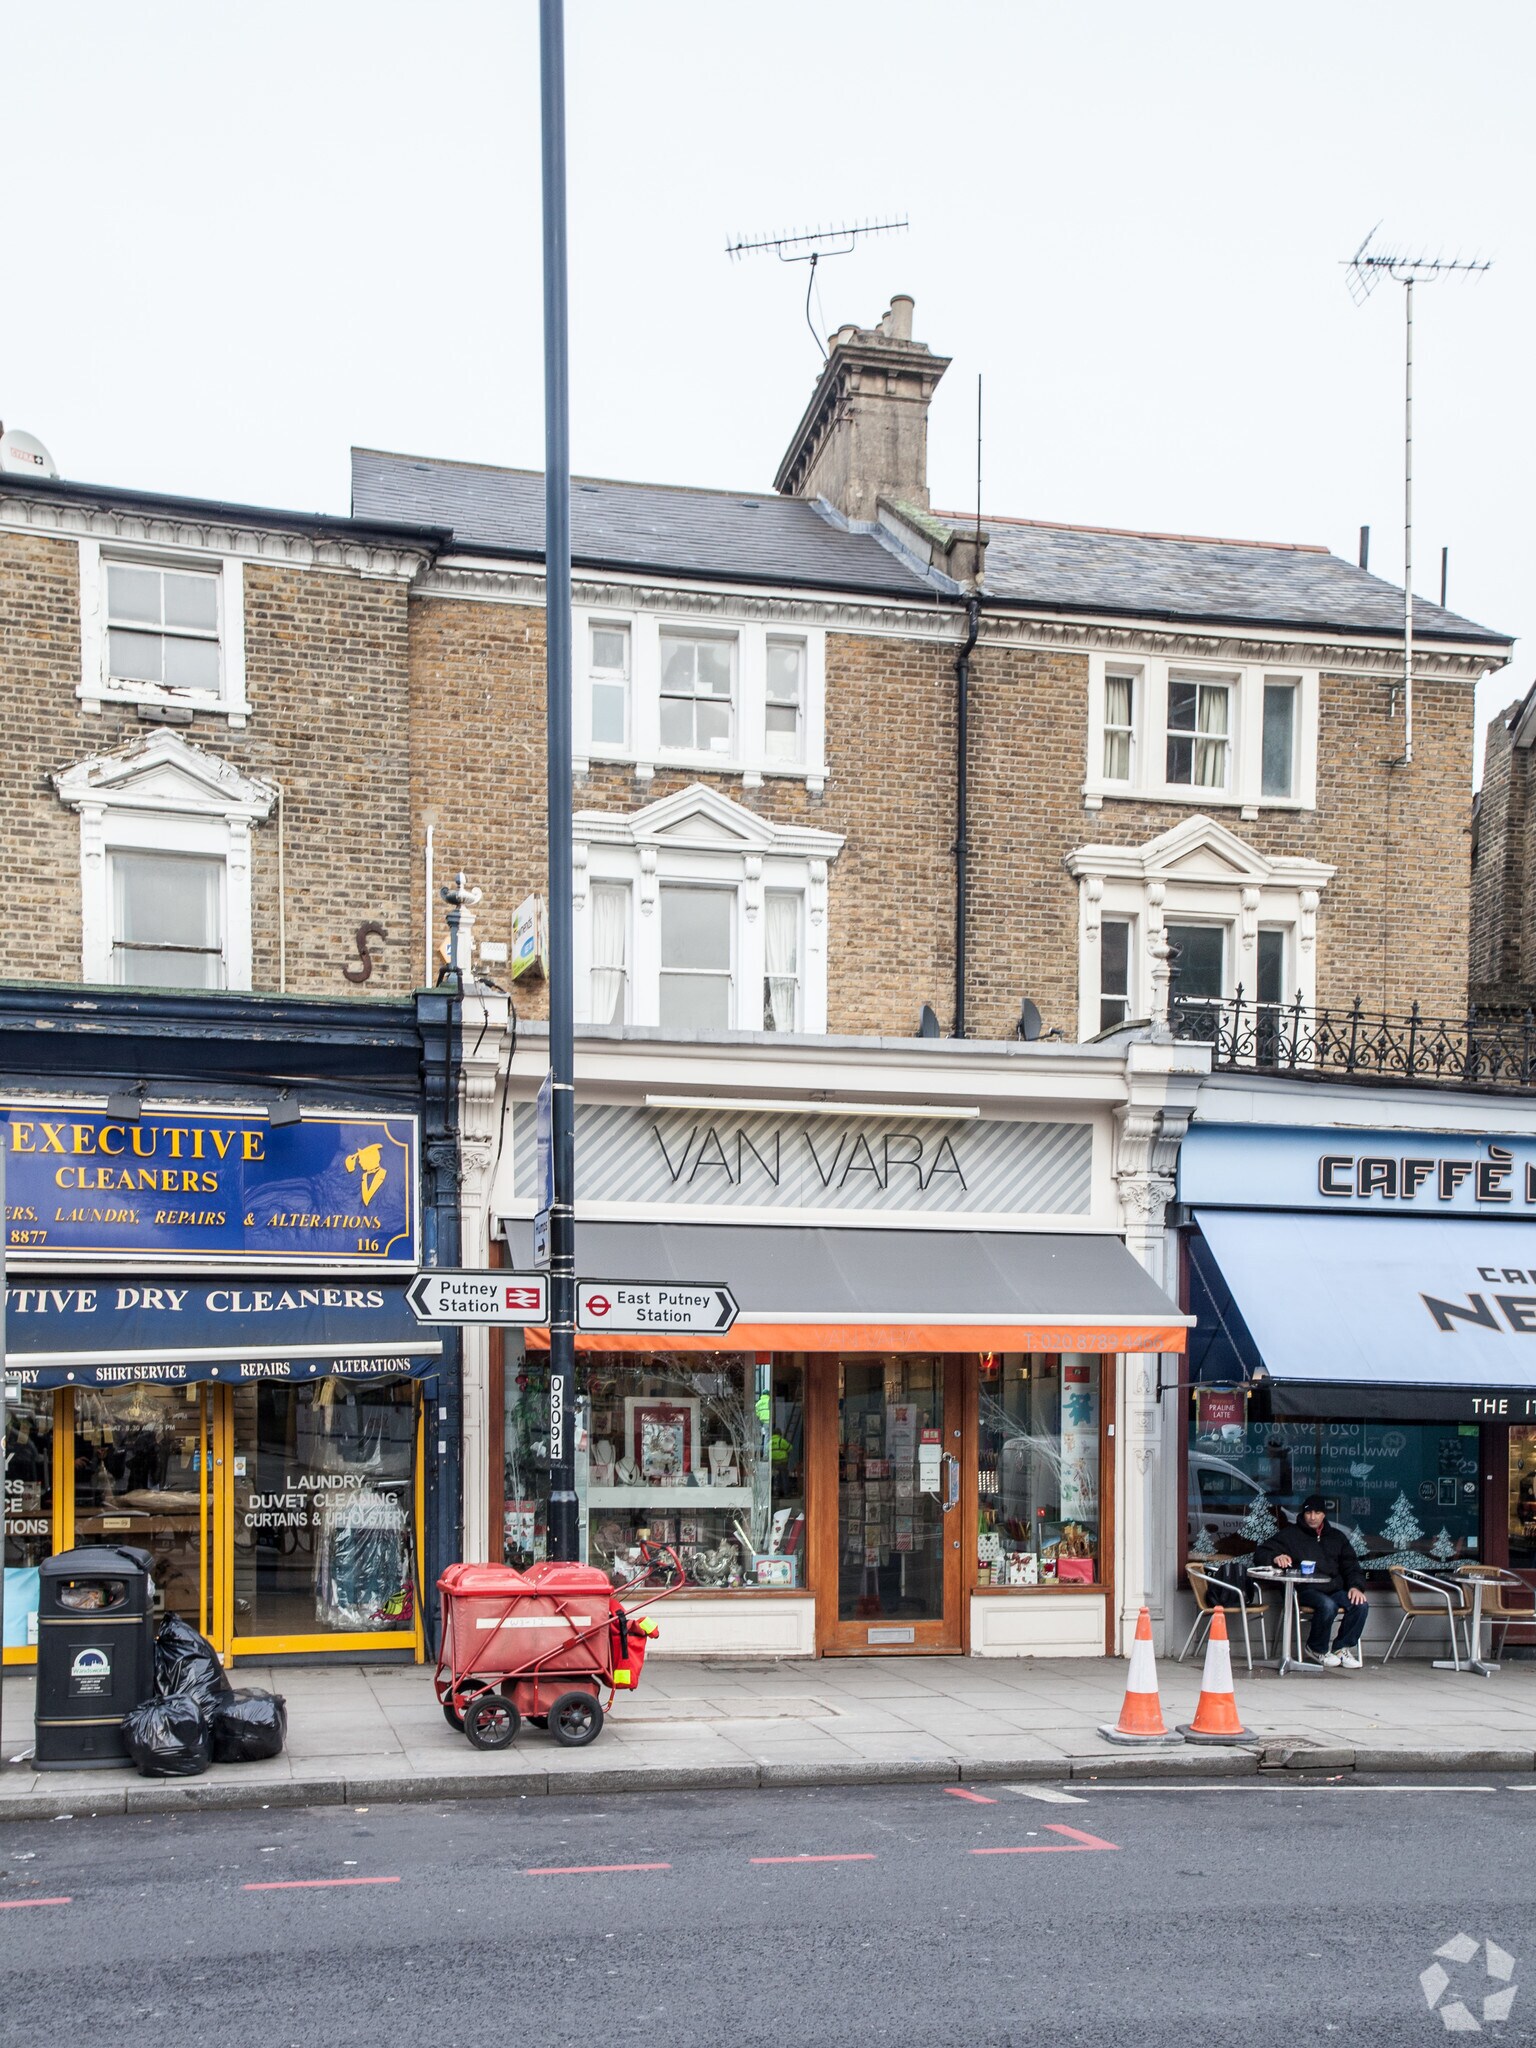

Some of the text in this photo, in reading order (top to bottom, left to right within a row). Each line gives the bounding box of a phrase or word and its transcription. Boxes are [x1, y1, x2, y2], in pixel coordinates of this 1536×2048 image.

[9, 1122, 266, 1161] EXECUTIVE
[652, 1125, 968, 1191] VAN VARA
[55, 1166, 219, 1193] CLEANERS
[1319, 1144, 1514, 1203] CAFFÈ
[55, 1207, 141, 1225] LAUNDRY,
[154, 1210, 226, 1226] REPAIRS
[243, 1212, 255, 1226] &
[267, 1213, 382, 1230] ALTERATIONS
[10, 1230, 48, 1244] 8877
[357, 1238, 380, 1252] 116
[441, 1281, 498, 1298] Putney
[115, 1288, 189, 1312] DRY
[206, 1289, 385, 1312] CLEANERS
[439, 1299, 499, 1312] Station
[618, 1291, 710, 1309] East Putney
[636, 1308, 691, 1322] Station
[1041, 1334, 1073, 1350] 020
[1123, 1335, 1164, 1351] 4466
[241, 1362, 290, 1377] REPAIRS
[331, 1358, 411, 1374] ALTERATIONS
[1209, 1404, 1235, 1412] PRALINE
[1213, 1411, 1231, 1419] LATTE
[1472, 1398, 1508, 1415] THE
[551, 1377, 562, 1458] 03094
[286, 1474, 366, 1490] LAUNDRY
[249, 1492, 398, 1509] DUVET CLEANING
[244, 1511, 411, 1528] CURTAINS & UPHOLSTERY
